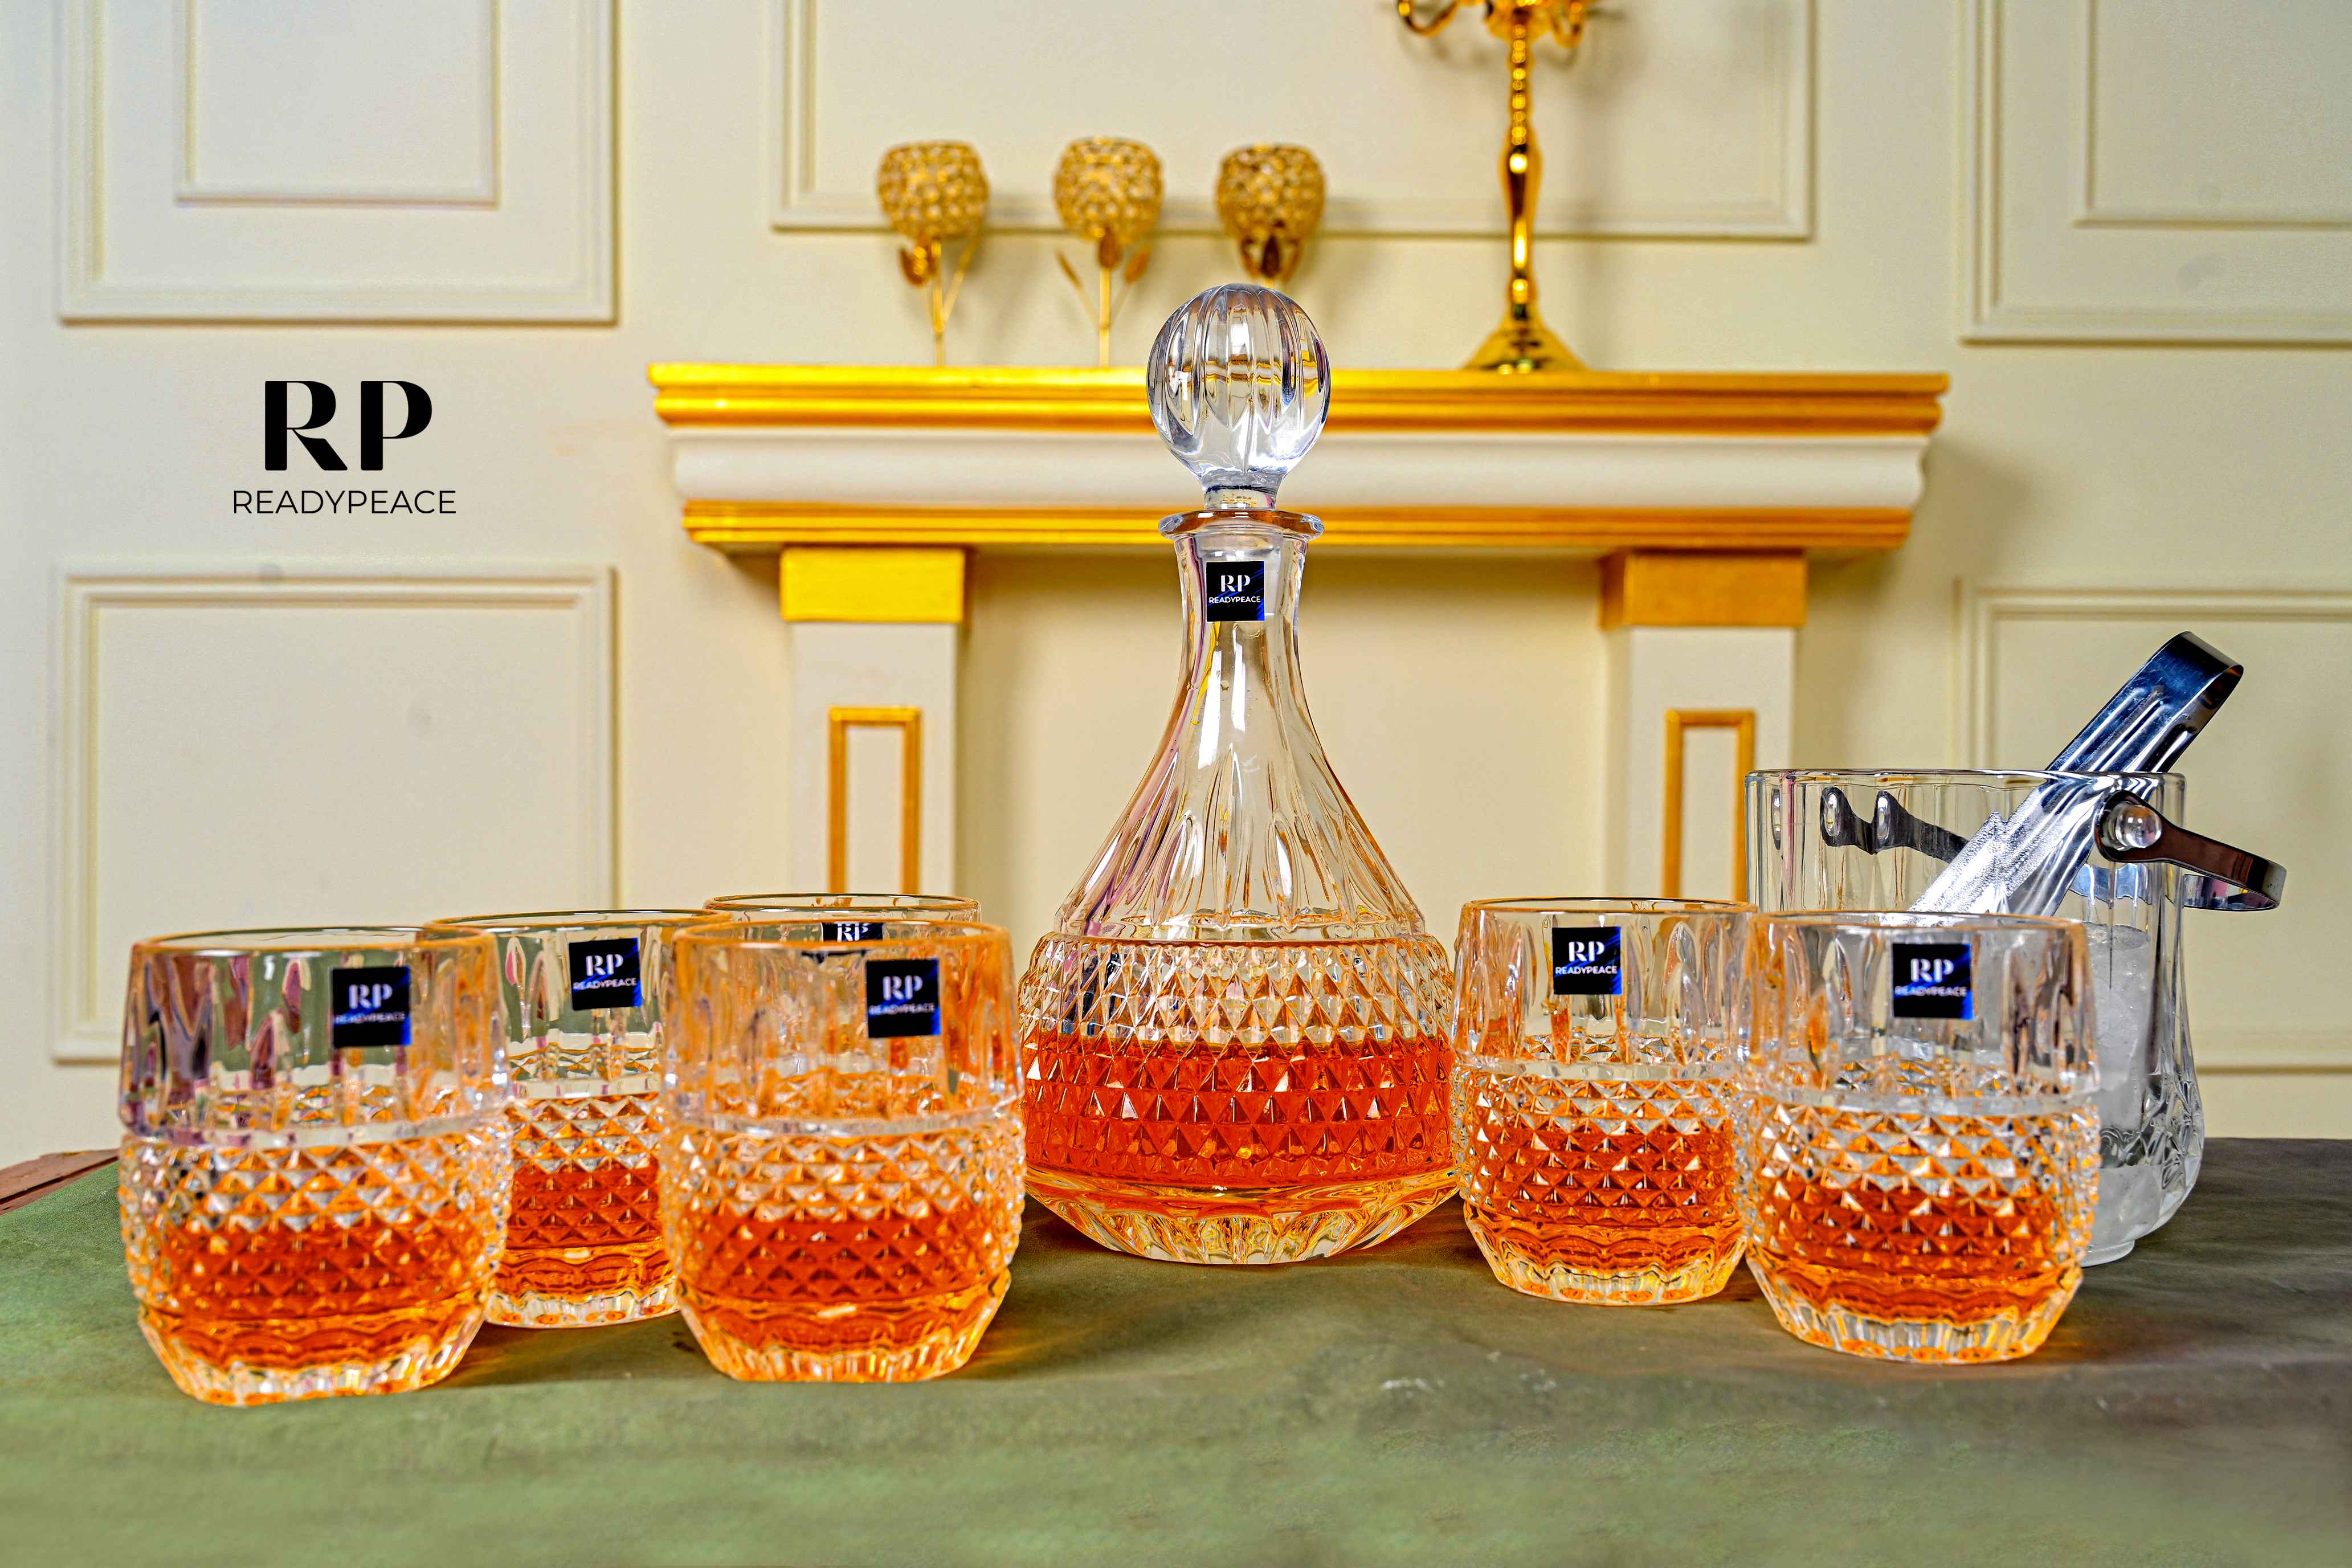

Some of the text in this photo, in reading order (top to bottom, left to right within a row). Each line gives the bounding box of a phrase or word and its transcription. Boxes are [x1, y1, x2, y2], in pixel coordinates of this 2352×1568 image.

[1220, 575, 1251, 592] RP
[837, 922, 869, 942] RP
[1569, 941, 1605, 962] RP
[586, 954, 624, 976] RP
[1555, 965, 1618, 974] READYPEACE
[1910, 958, 1954, 982] RP
[573, 978, 637, 990] READYPEACE
[883, 975, 922, 1001] RP
[349, 983, 393, 1009] RP
